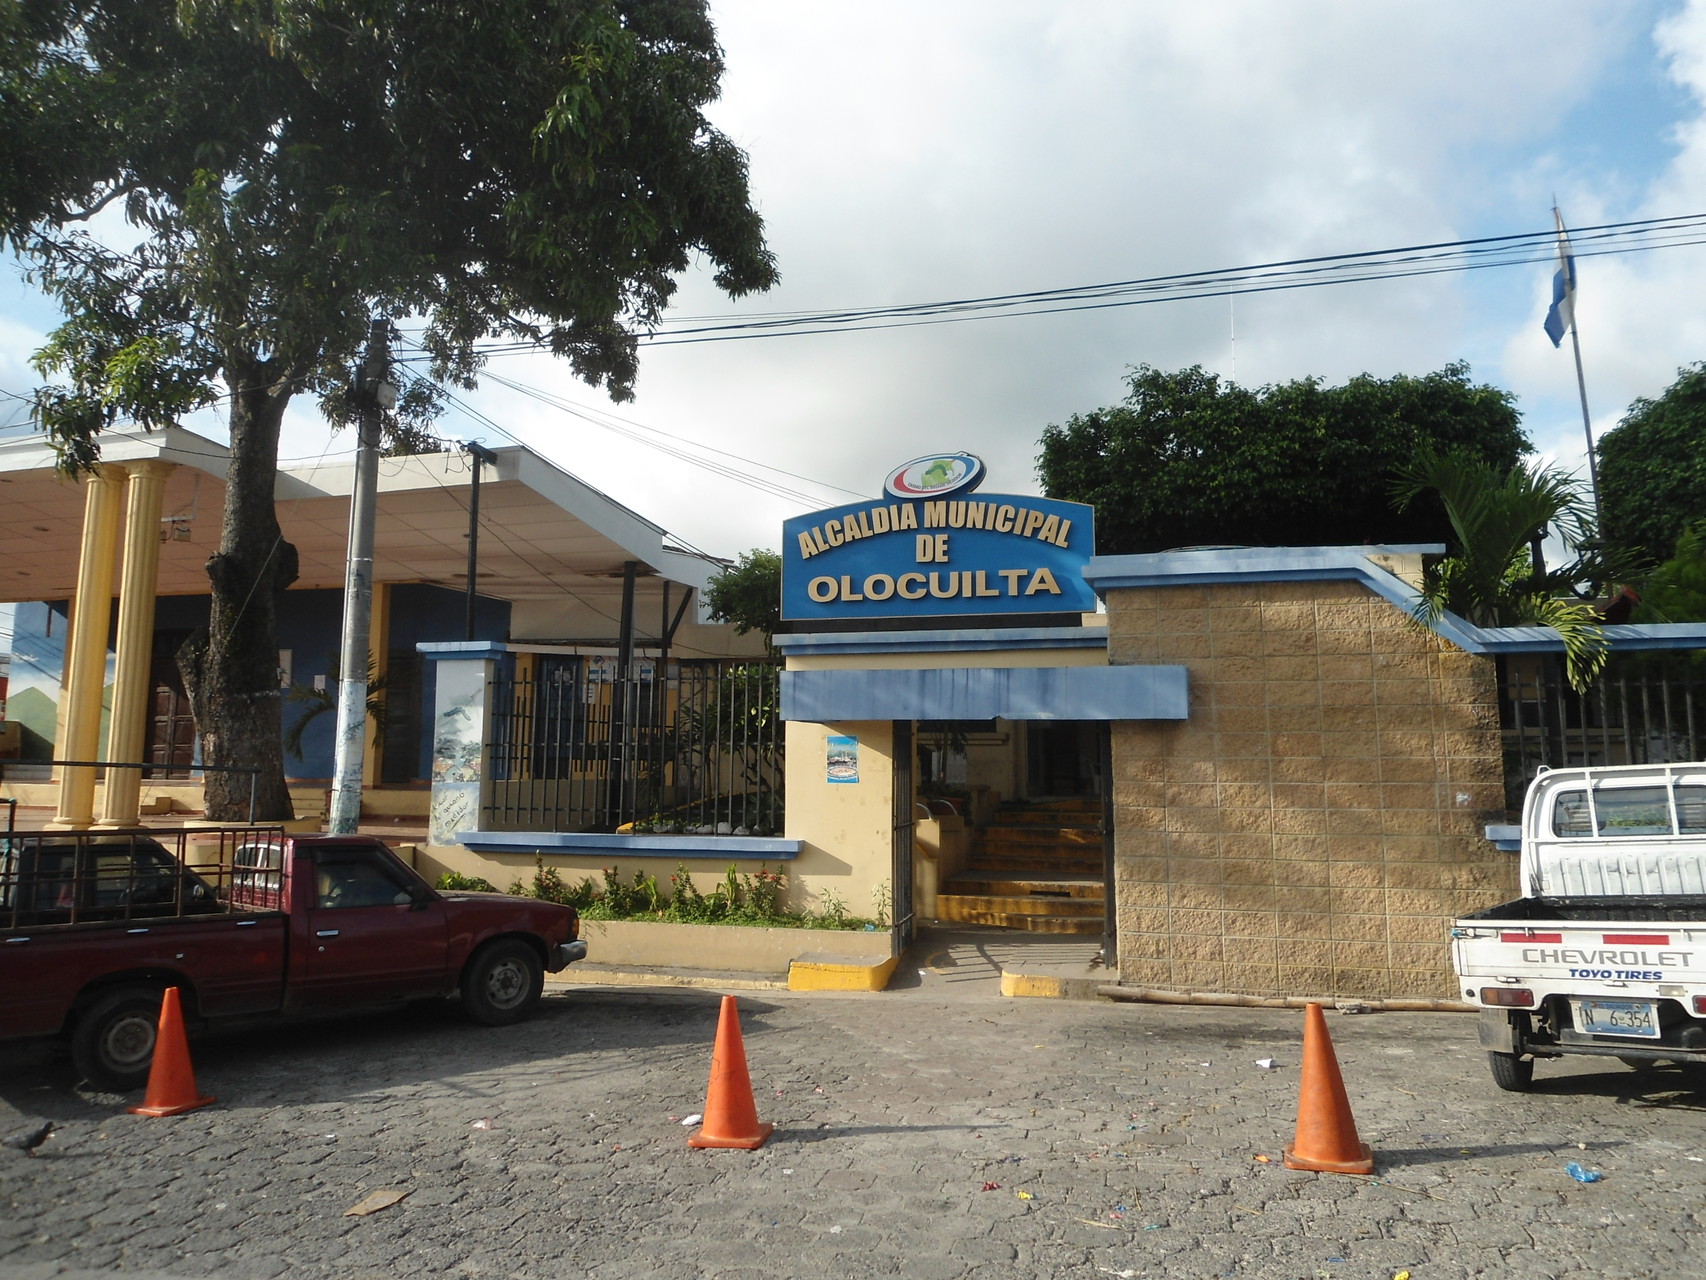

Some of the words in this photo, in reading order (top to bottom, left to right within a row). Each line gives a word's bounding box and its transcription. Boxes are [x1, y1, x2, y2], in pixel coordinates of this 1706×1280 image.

[798, 502, 918, 560] ALCALDIA
[924, 500, 1072, 549] MUNICIPAL
[916, 533, 949, 563] DE
[807, 567, 1062, 603] OLOCUILTA
[1522, 948, 1694, 967] CHEVROLET
[1569, 968, 1612, 979] TOYO
[1615, 970, 1662, 980] TIRES
[1584, 1008, 1595, 1025] N
